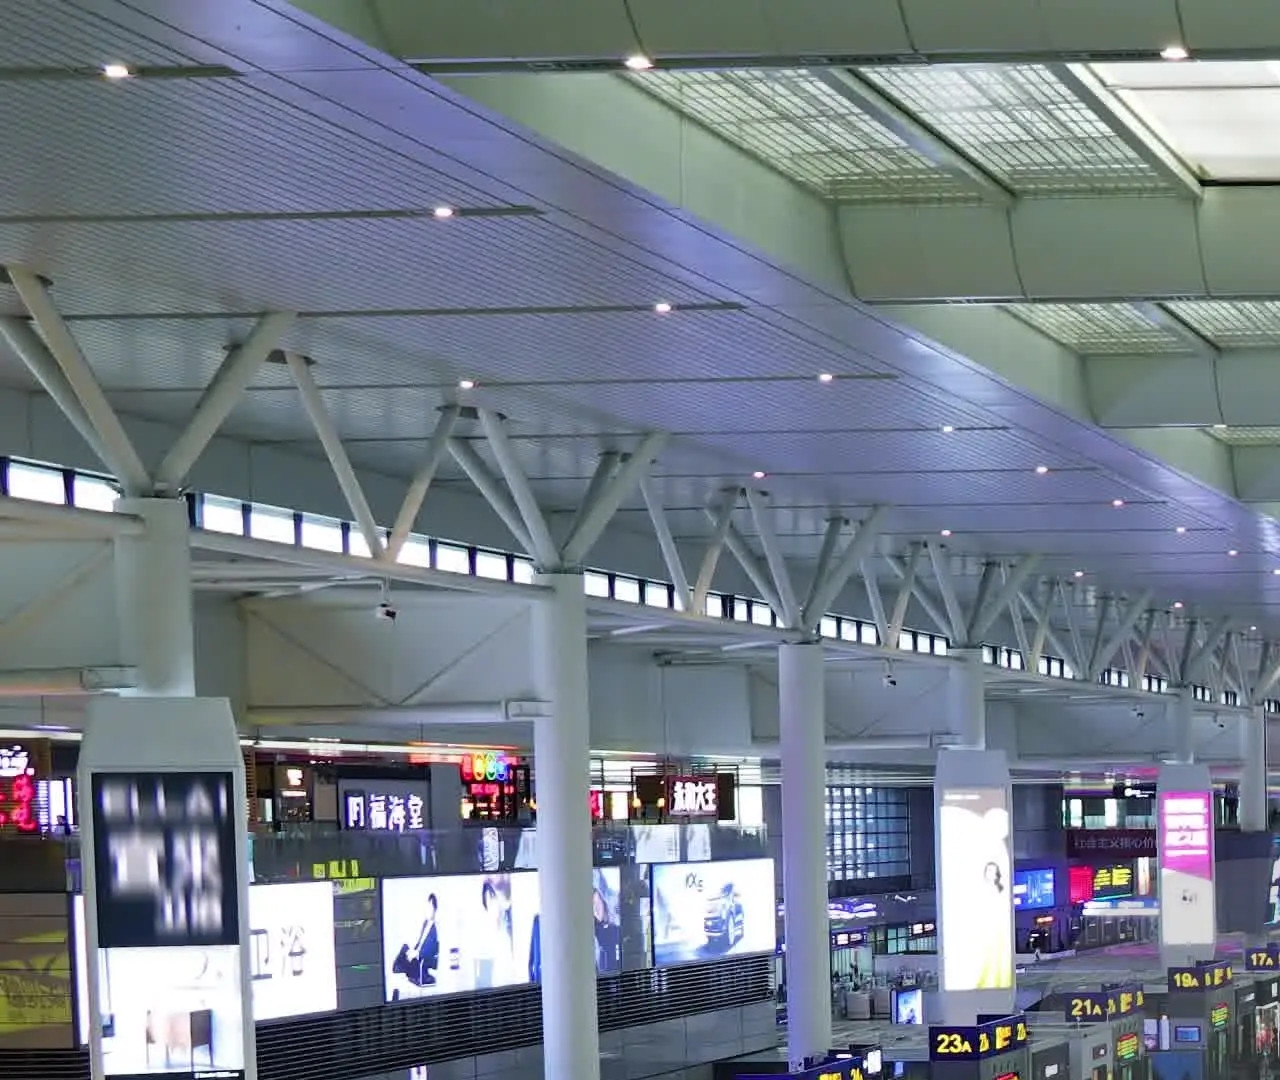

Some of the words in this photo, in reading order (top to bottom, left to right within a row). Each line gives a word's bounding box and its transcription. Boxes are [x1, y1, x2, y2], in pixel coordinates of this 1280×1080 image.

[1073, 834, 1158, 851] 社会主义核心价
[1250, 952, 1274, 966] 17A
[1173, 972, 1199, 988] 19A
[1073, 999, 1102, 1016] 21A
[937, 1033, 972, 1054] 23A
